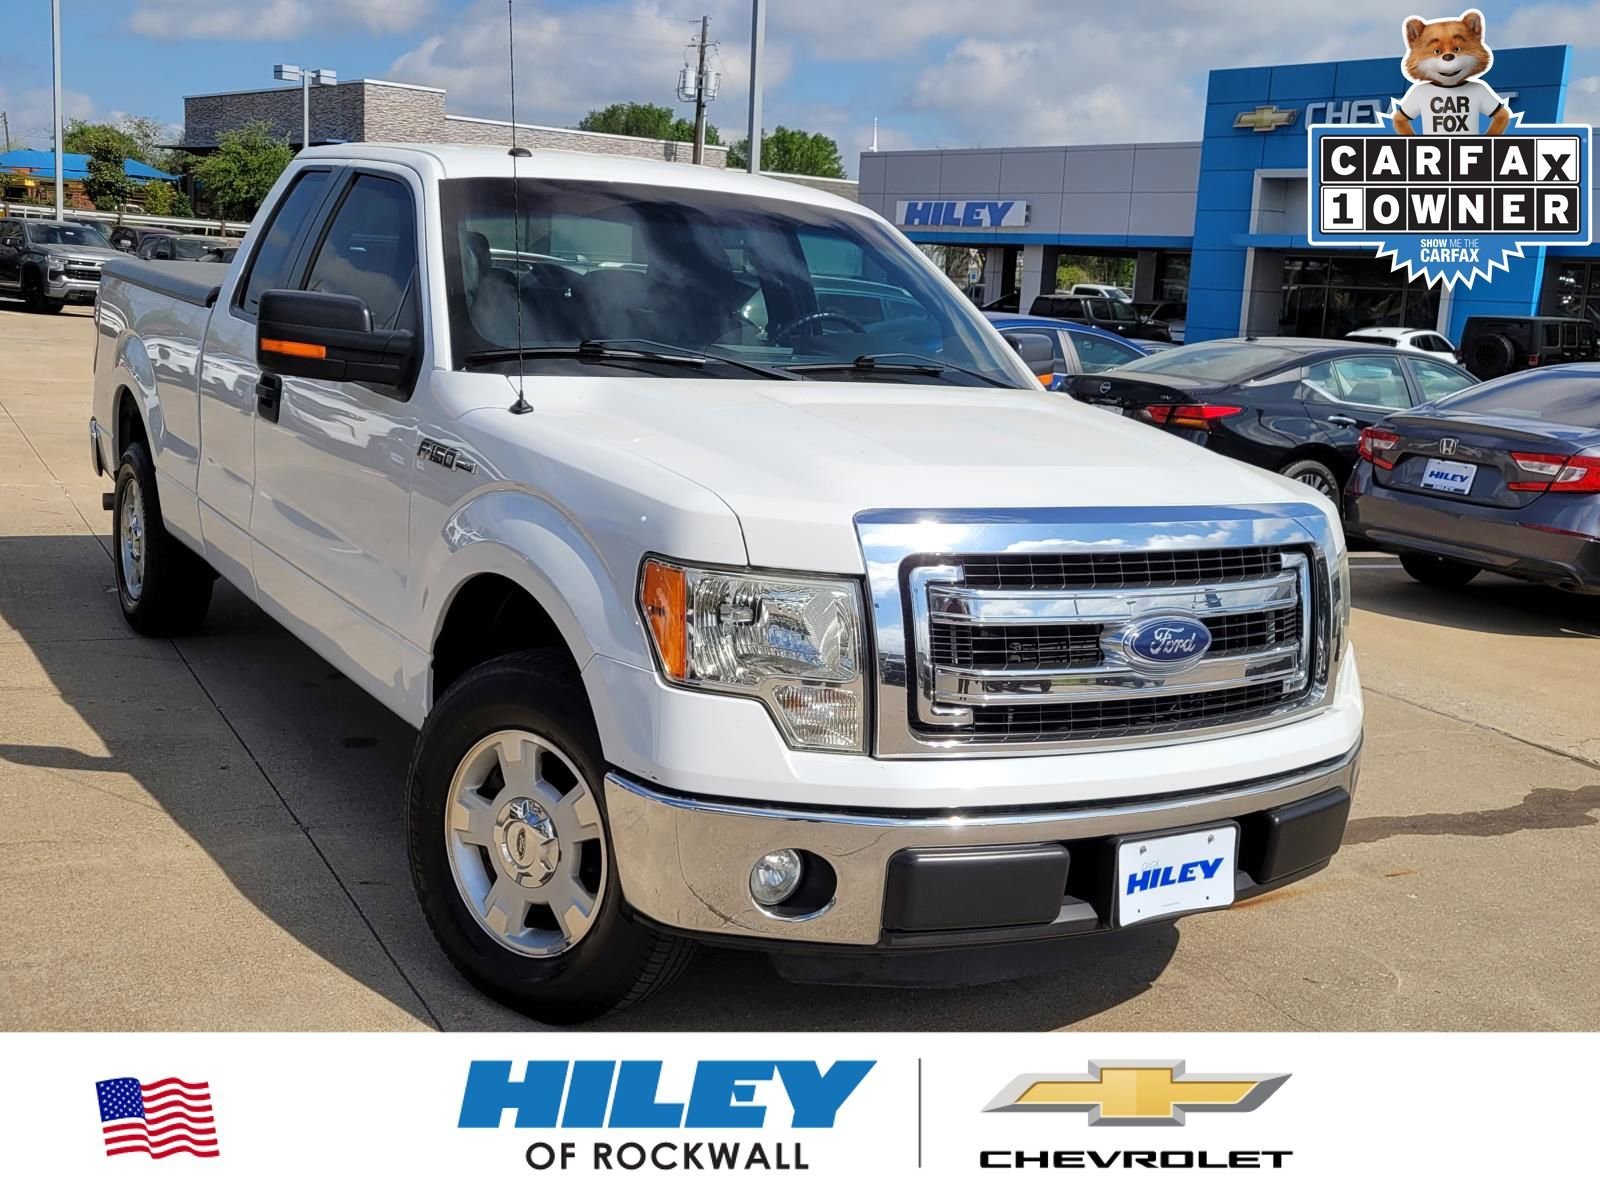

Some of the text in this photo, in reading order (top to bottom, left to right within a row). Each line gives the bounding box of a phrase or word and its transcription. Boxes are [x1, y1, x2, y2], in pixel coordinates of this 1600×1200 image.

[905, 202, 1015, 227] HILEY
[1428, 470, 1469, 482] HILEY
[1150, 627, 1196, 655] Ford
[1126, 857, 1225, 896] HILEY
